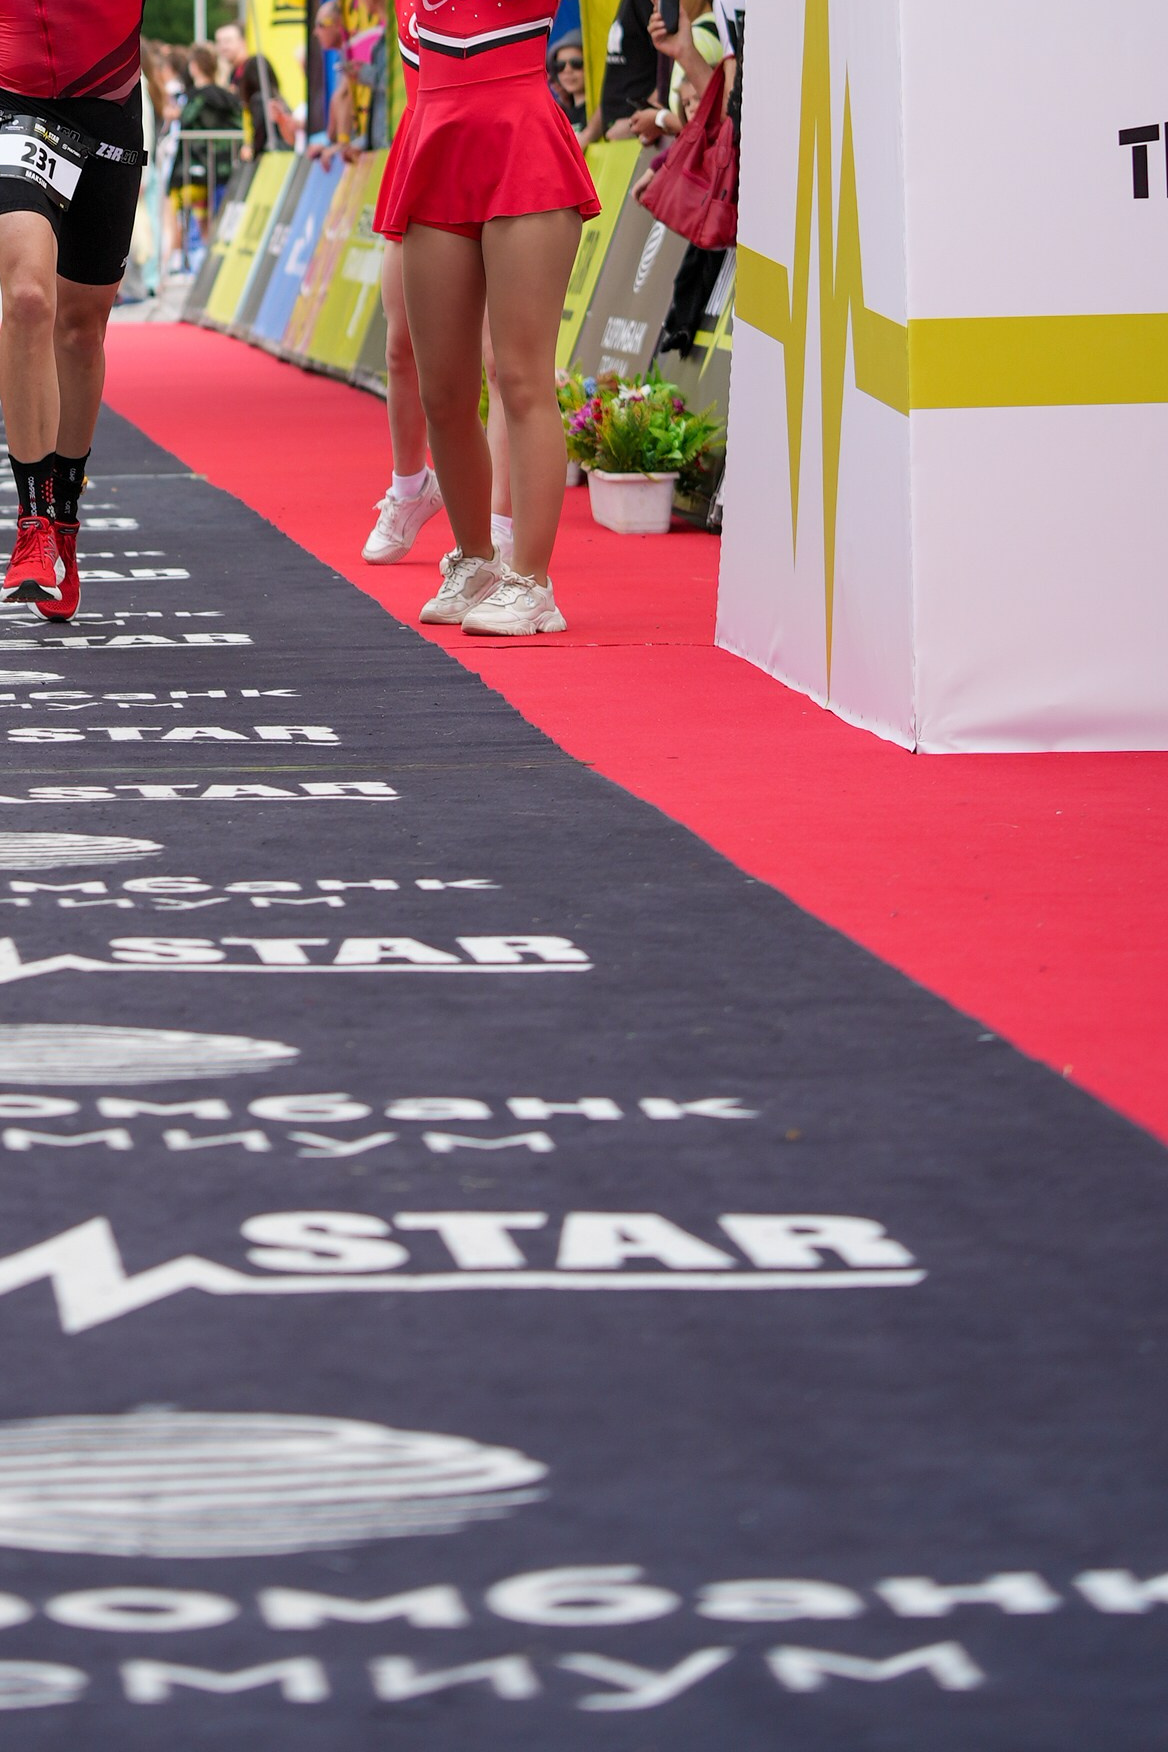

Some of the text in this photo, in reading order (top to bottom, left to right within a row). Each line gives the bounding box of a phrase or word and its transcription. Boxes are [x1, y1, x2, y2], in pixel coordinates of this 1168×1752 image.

[20, 141, 57, 180] 231
[7, 725, 340, 743] STAR
[27, 781, 400, 800] STAR
[108, 933, 590, 965] STAR
[241, 1210, 914, 1273] STAR
